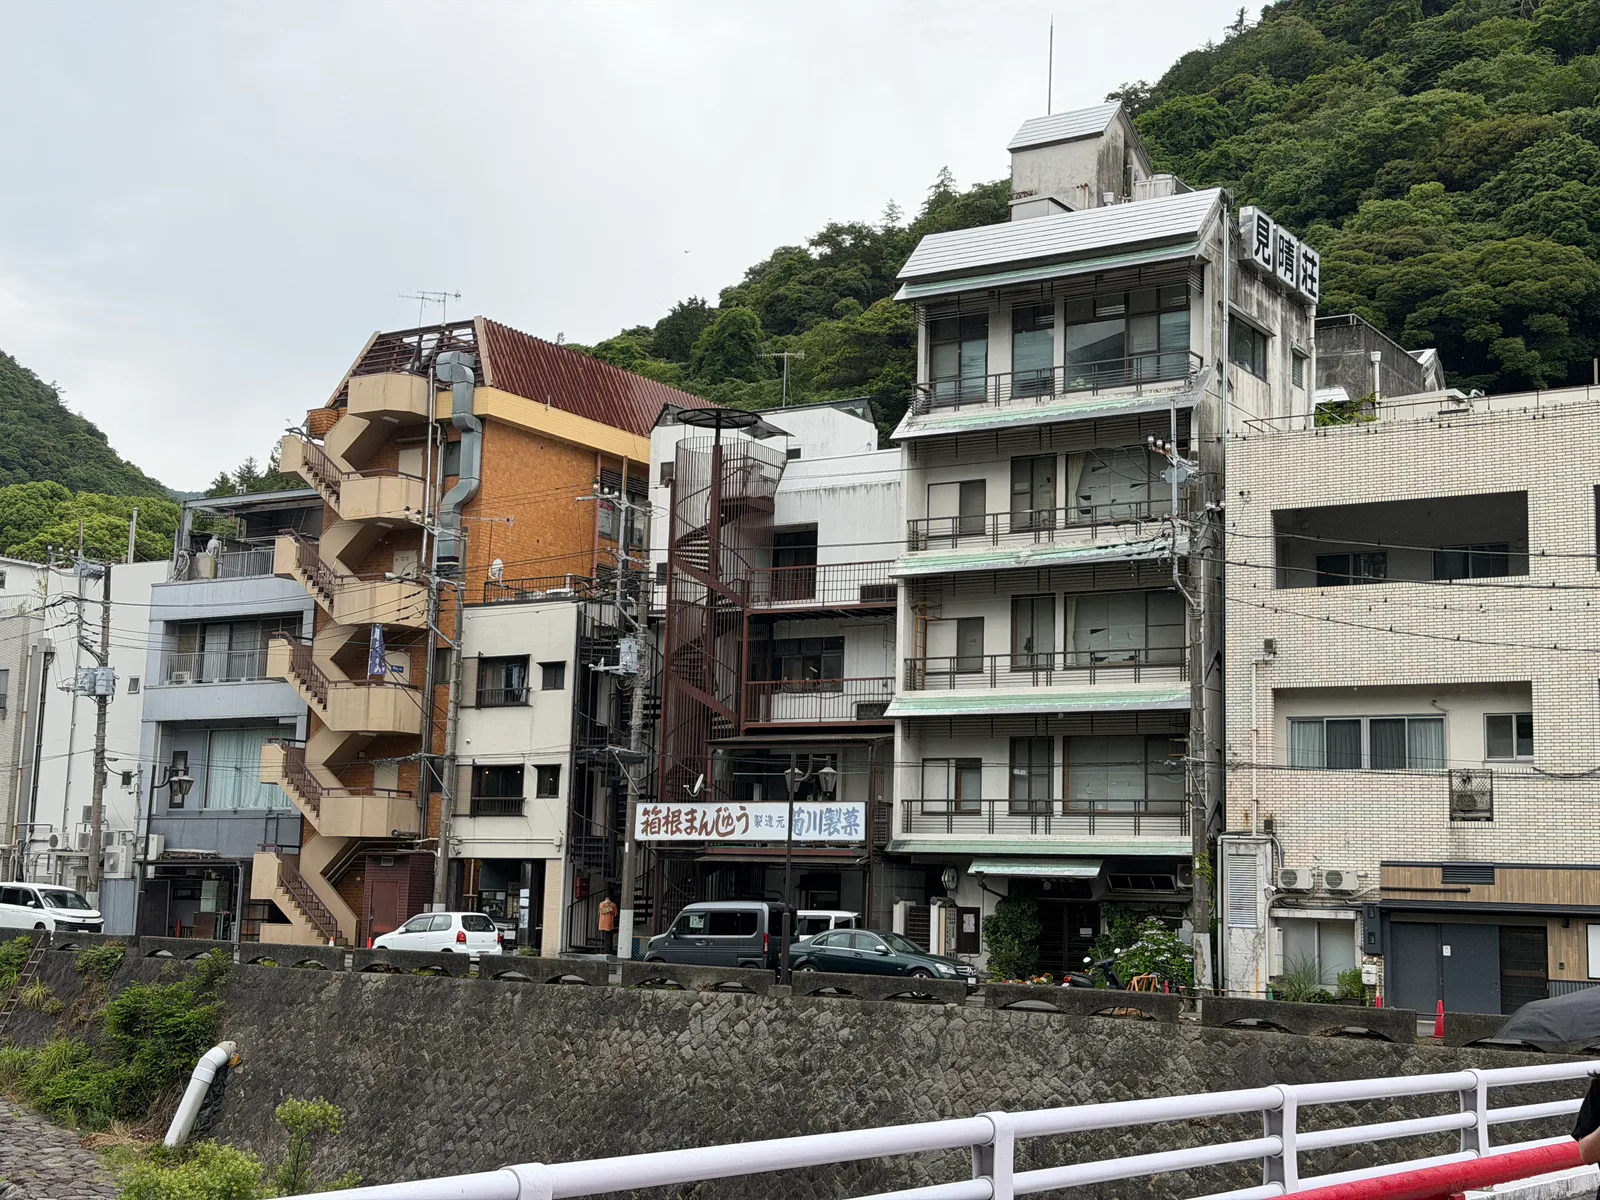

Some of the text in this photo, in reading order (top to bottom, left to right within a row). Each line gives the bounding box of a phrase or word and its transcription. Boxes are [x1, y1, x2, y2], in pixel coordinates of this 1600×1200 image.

[1254, 213, 1318, 298] 見晴荘
[641, 805, 749, 837] 箱根まんじゅう
[754, 814, 785, 828] 製造元
